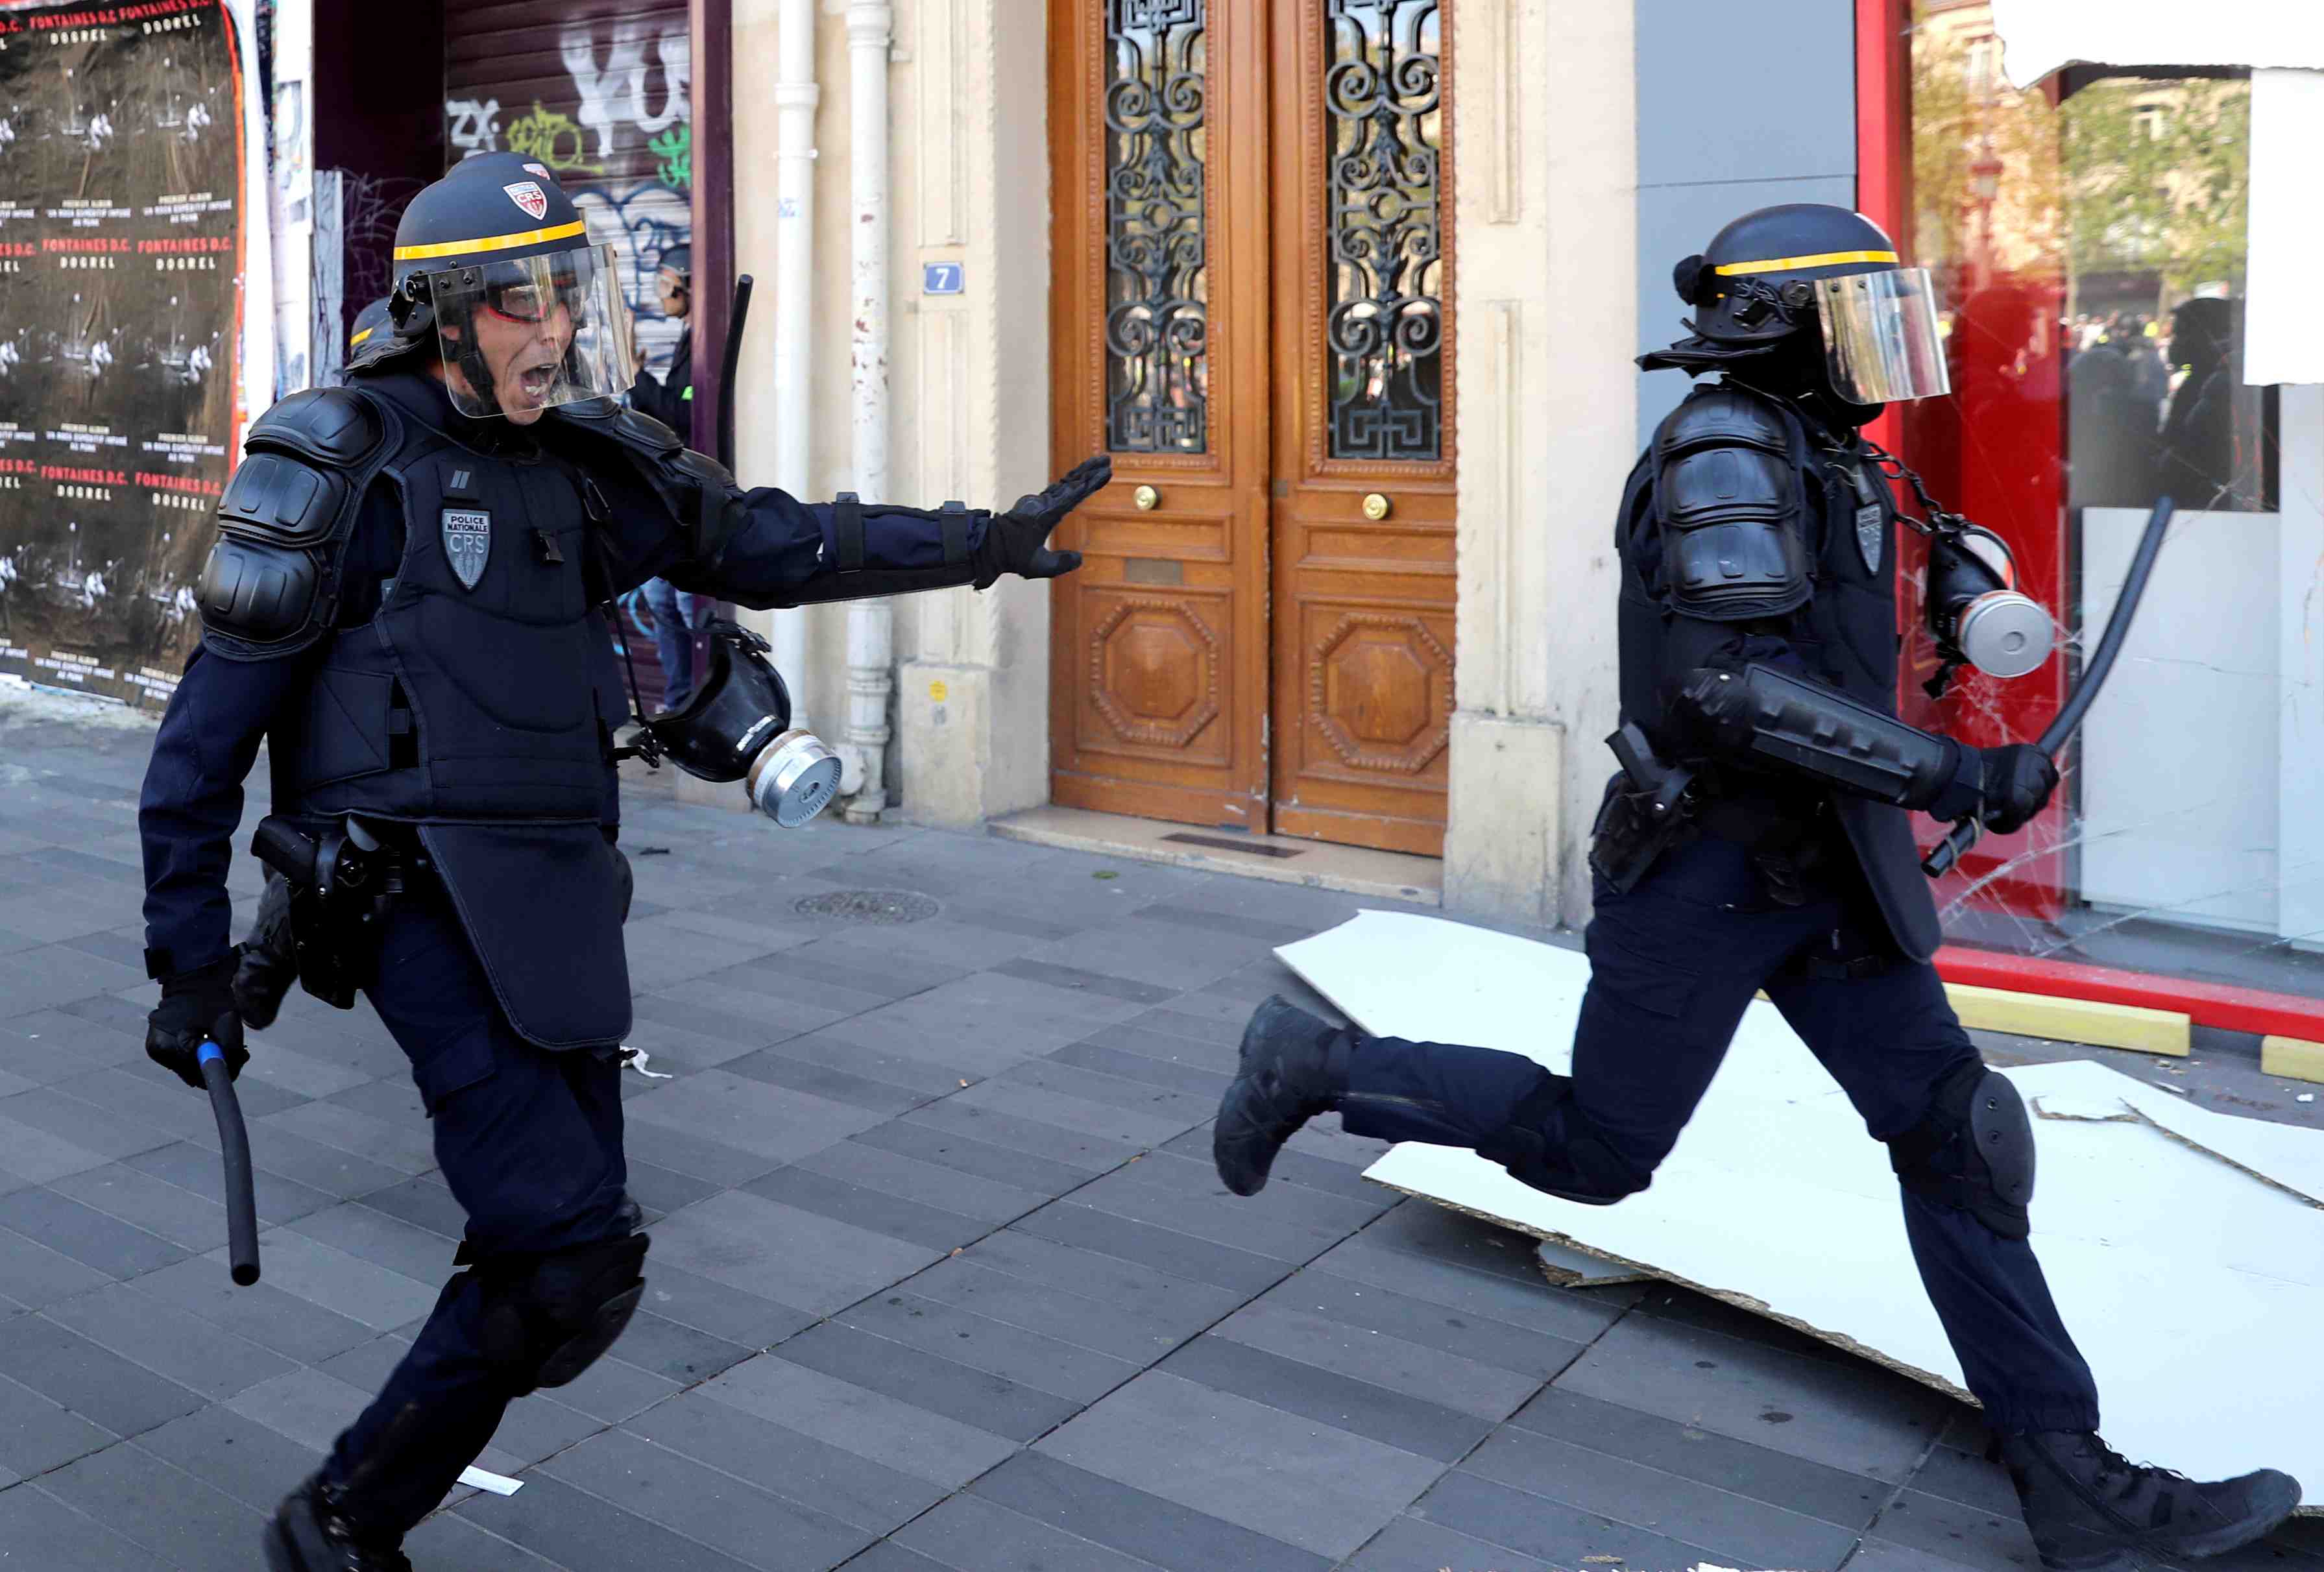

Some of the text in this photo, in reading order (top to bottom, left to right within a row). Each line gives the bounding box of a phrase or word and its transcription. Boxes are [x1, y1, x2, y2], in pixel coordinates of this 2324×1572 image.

[142, 13, 201, 35] DOGREL
[50, 29, 107, 45] DOGREL
[516, 191, 542, 203] CRS
[42, 238, 131, 253] FONTAINES D.C.
[138, 238, 207, 254] FONTAINES
[60, 256, 115, 269] DOGREL
[156, 256, 215, 271] DOGREL
[936, 268, 949, 289] 7
[41, 465, 128, 485] FONTAINES D.C.
[135, 472, 200, 493] FONTAINES
[57, 485, 111, 501] DOGREL
[152, 492, 205, 511] DOGREL
[447, 523, 488, 532] NATIONALE
[451, 516, 484, 524] POLICE
[450, 533, 484, 553] CRS
